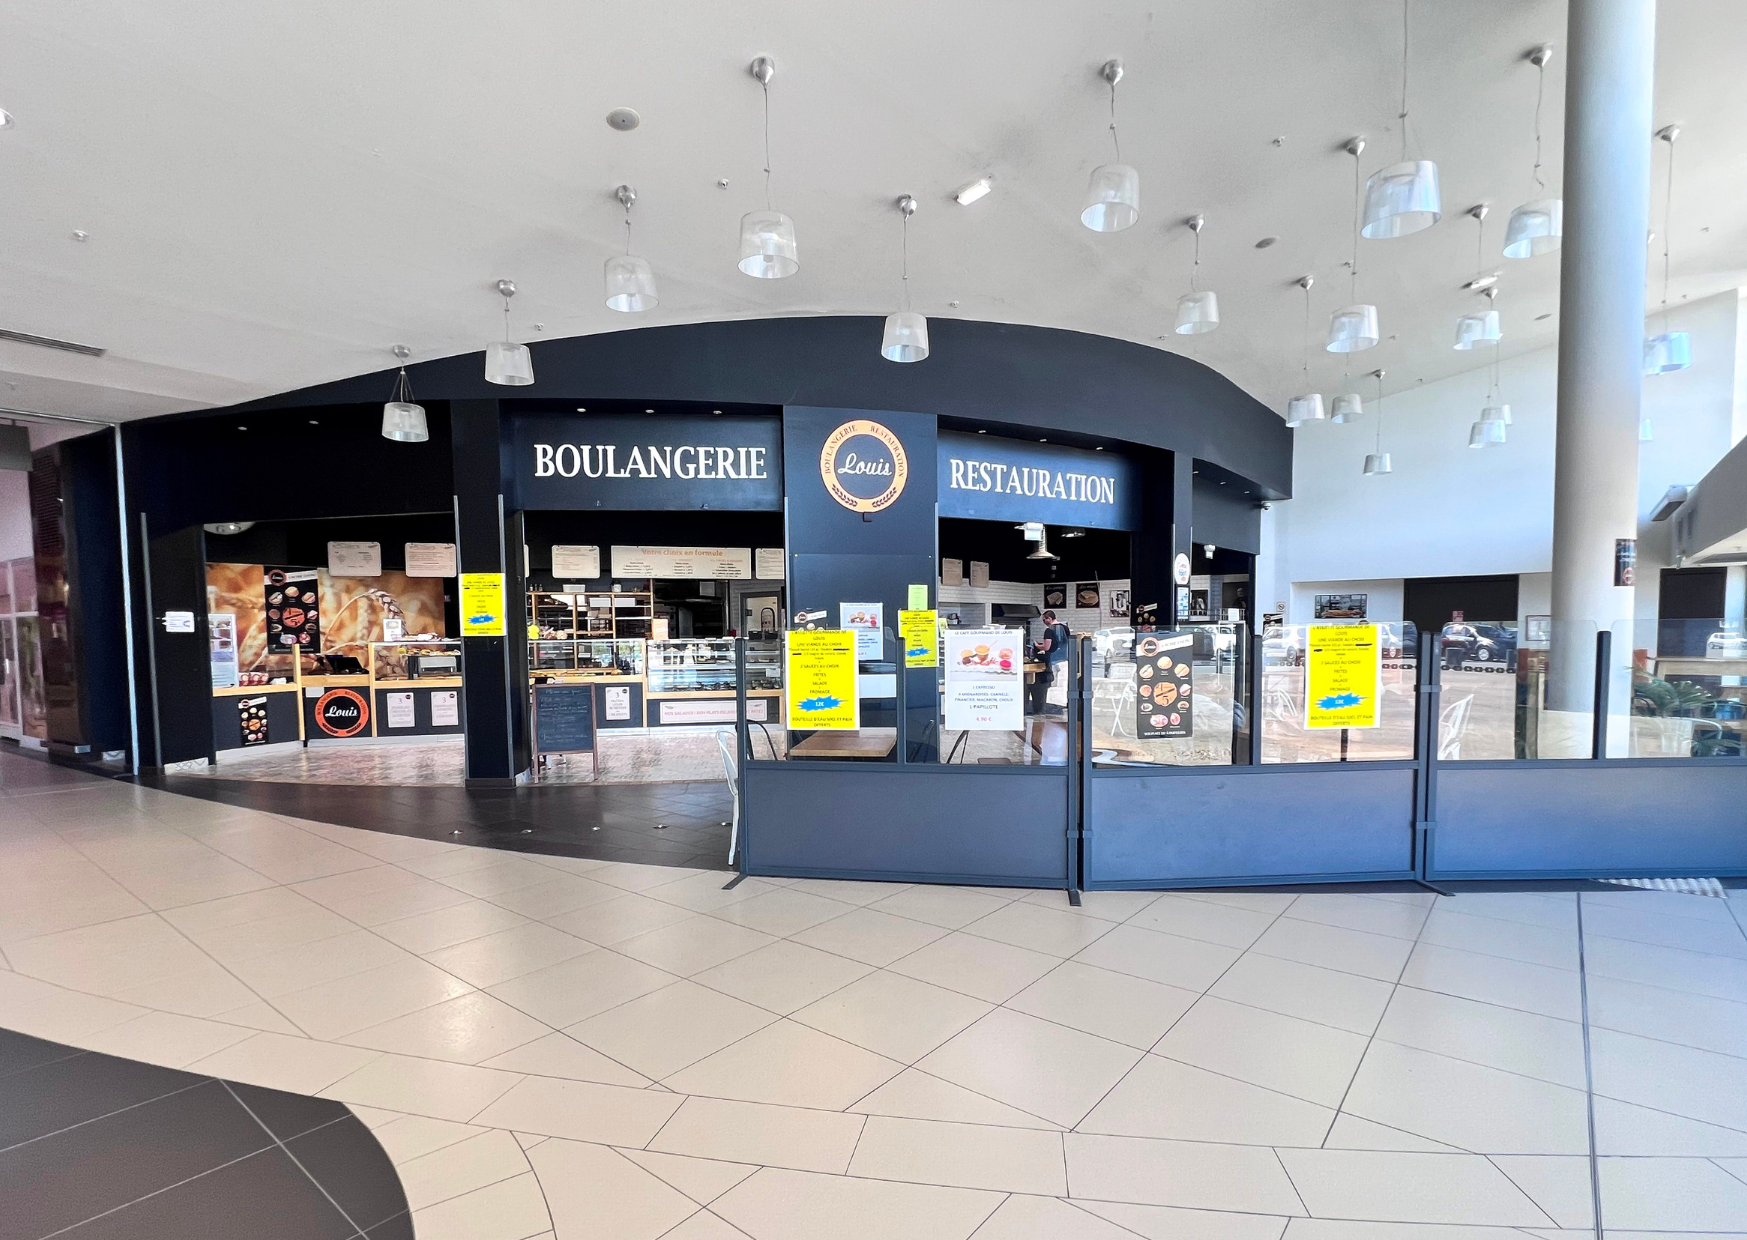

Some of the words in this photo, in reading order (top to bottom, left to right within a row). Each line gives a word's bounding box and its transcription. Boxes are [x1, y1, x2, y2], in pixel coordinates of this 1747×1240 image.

[534, 444, 767, 479] BOULANGERIE
[824, 425, 857, 474] BOULANGERIE
[870, 425, 905, 478] RESTAURATION
[837, 453, 892, 476] Louis
[950, 459, 1115, 504] RESTAURATION
[694, 549, 723, 557] formule
[324, 705, 358, 717] Louis
